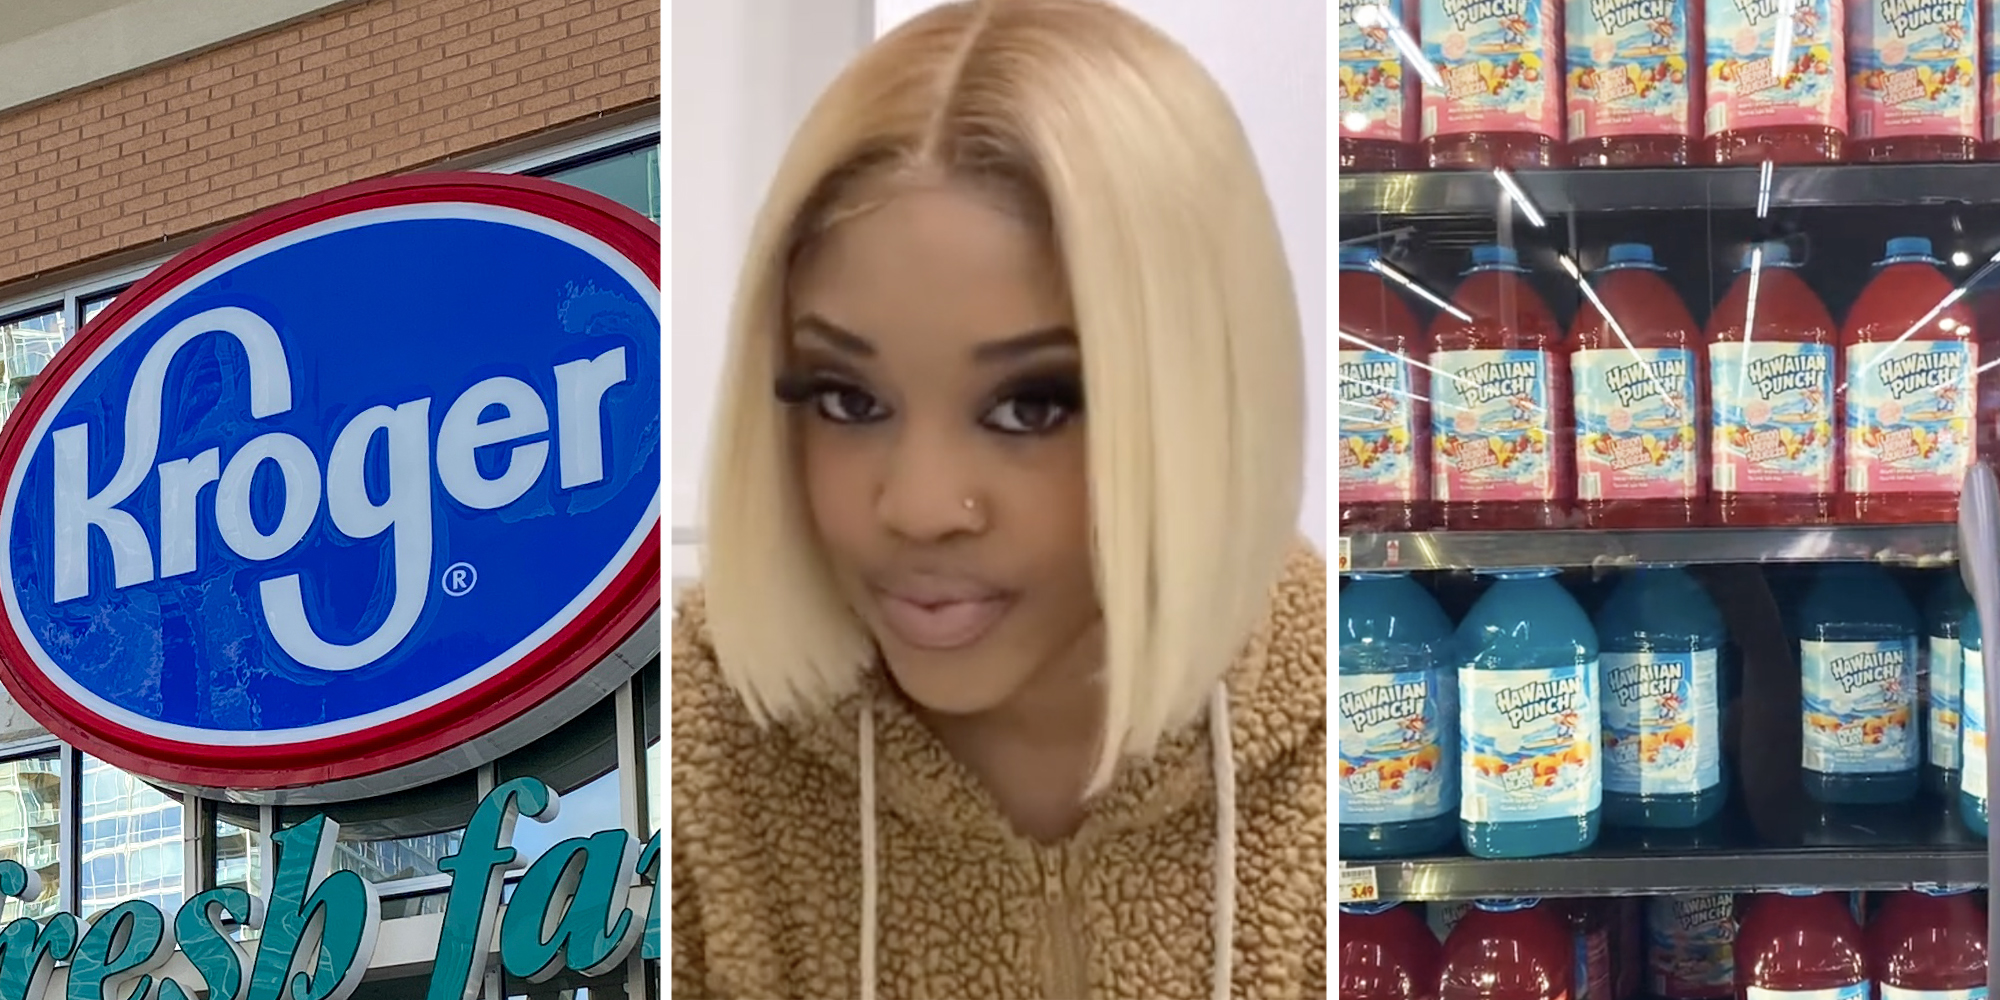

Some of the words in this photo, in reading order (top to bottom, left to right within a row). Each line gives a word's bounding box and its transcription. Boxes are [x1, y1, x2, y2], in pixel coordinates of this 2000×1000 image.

[1453, 361, 1537, 394] HAWAIIAN
[1605, 359, 1686, 392] HAWAIIAN
[1748, 353, 1826, 385] HAWAIIAN
[1879, 351, 1961, 385] HAWAIIAN
[53, 305, 627, 671] Kroger
[1608, 662, 1683, 693] HAWAIIAN
[1830, 650, 1904, 681] HAWAIIAN
[1339, 680, 1427, 717] HAWAIIAN
[1496, 676, 1581, 714] HAWAIIAN
[0, 813, 374, 1000] resh
[1351, 885, 1374, 899] 3.49
